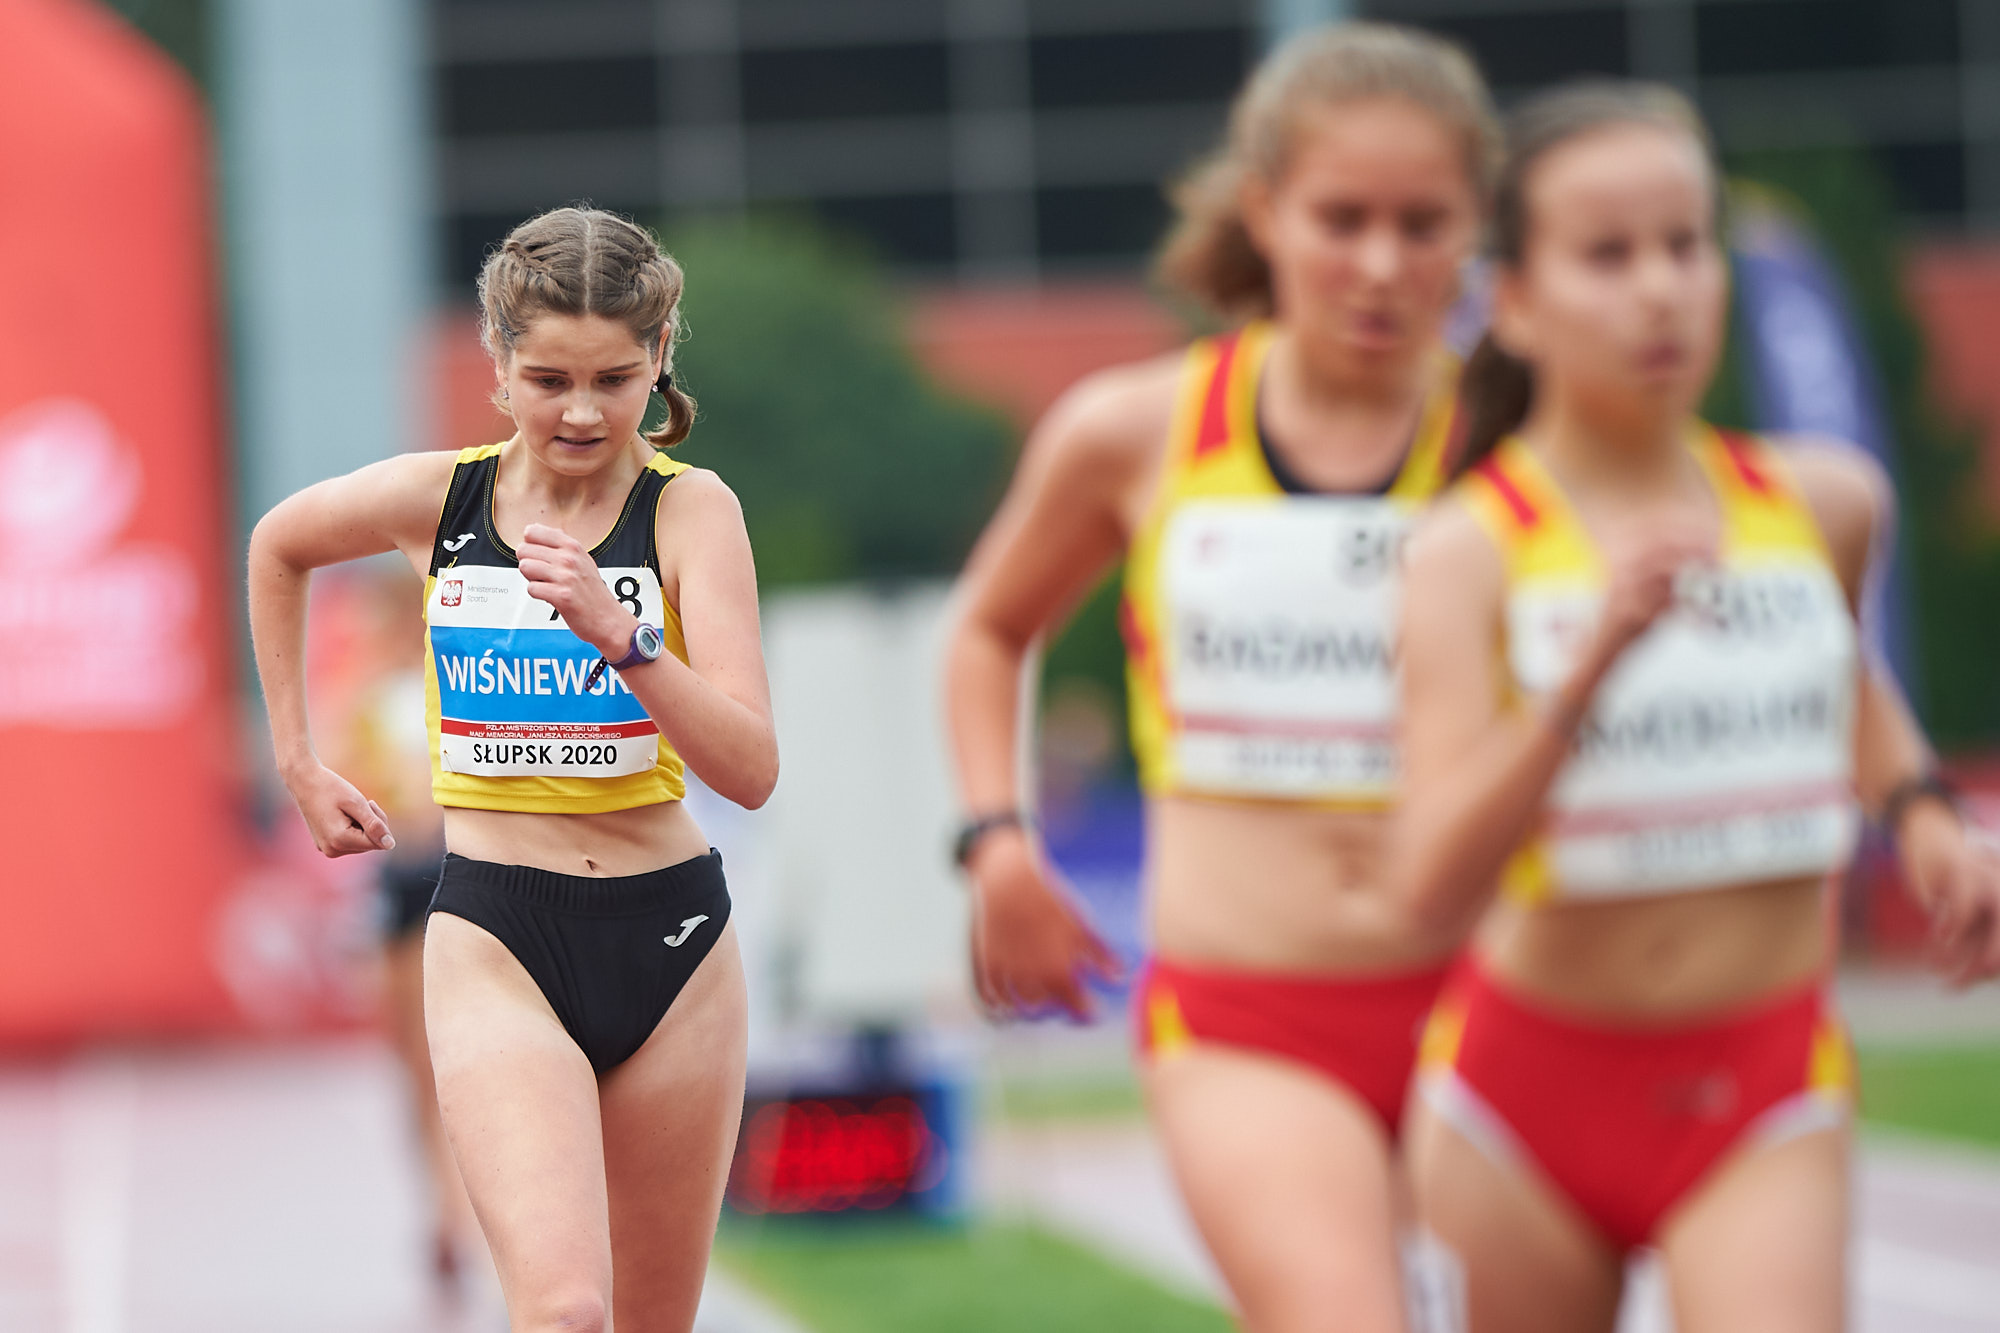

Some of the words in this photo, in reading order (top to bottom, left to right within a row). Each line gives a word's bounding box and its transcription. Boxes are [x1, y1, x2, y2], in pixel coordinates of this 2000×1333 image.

[441, 648, 633, 696] WIŚNIEWSK
[505, 724, 559, 732] MISTRZOSTWA
[563, 732, 622, 740] KUSOCIŃSKIEGO
[473, 743, 553, 765] SŁUPSK
[561, 745, 617, 765] 2020
